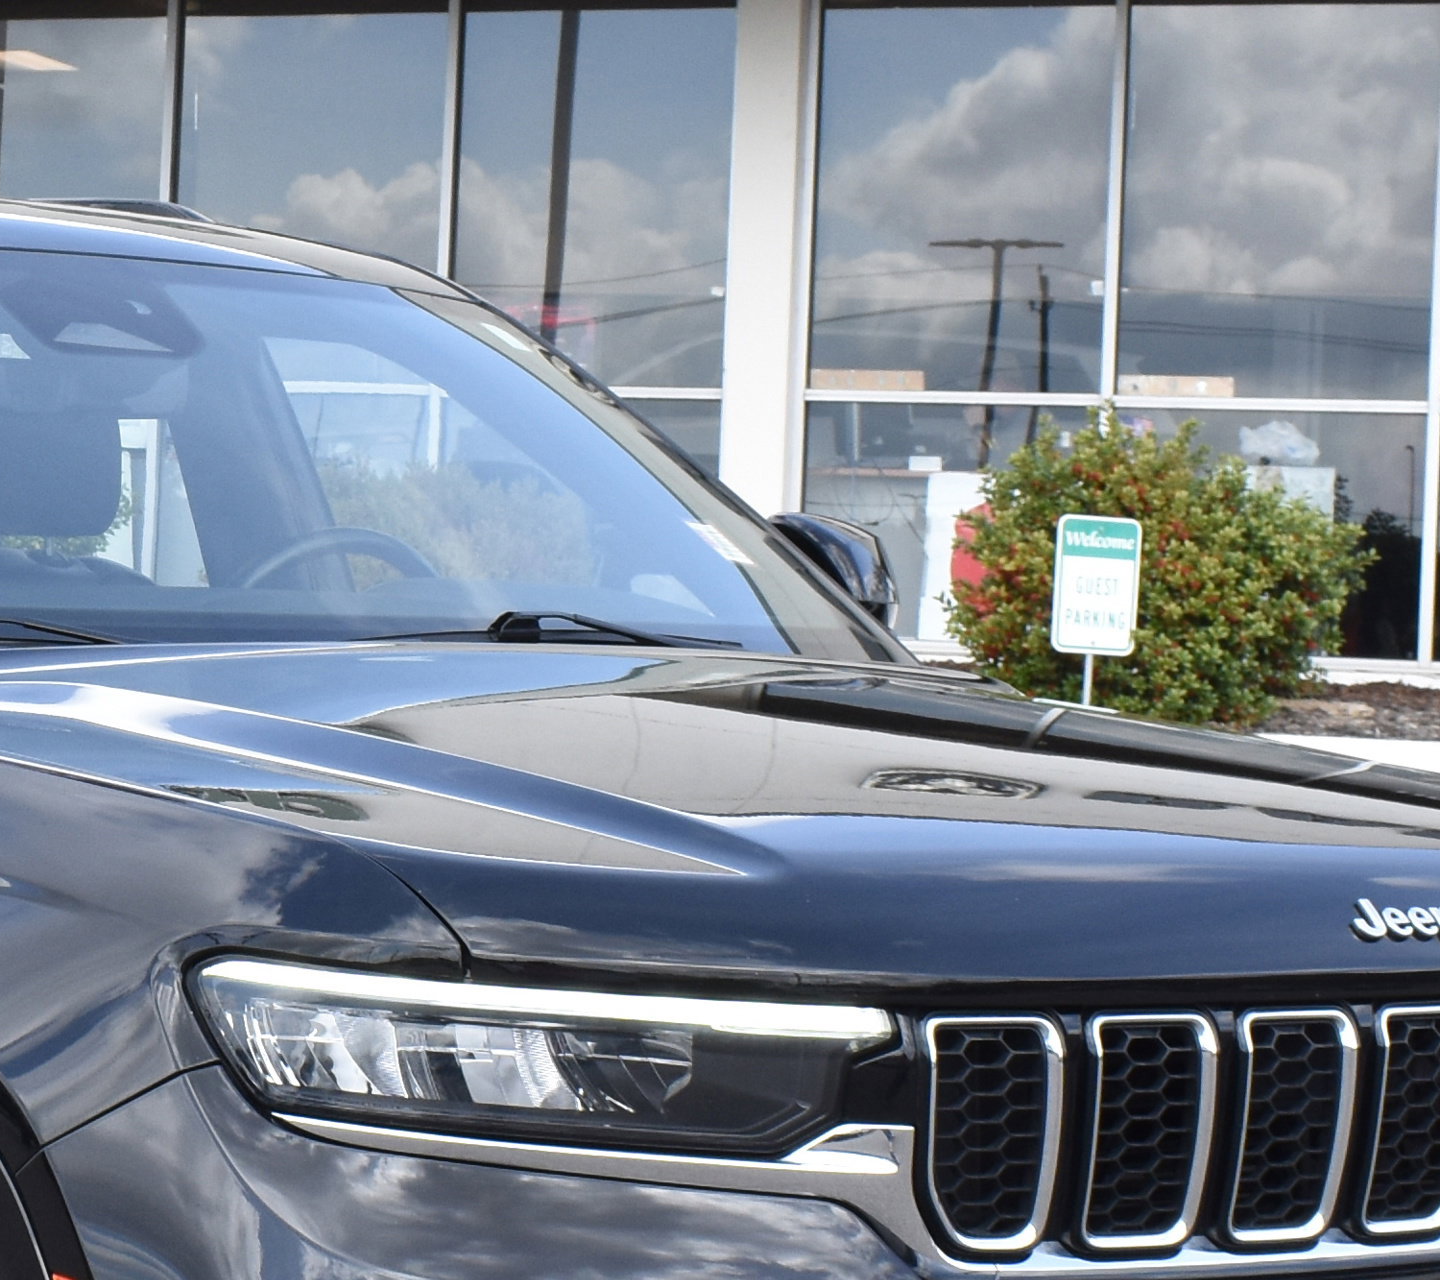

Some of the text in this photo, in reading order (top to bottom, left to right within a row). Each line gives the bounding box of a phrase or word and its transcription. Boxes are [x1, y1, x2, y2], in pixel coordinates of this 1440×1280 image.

[1065, 530, 1135, 550] Welcome
[1076, 576, 1119, 596] GUEST
[1065, 608, 1126, 630] PARKING
